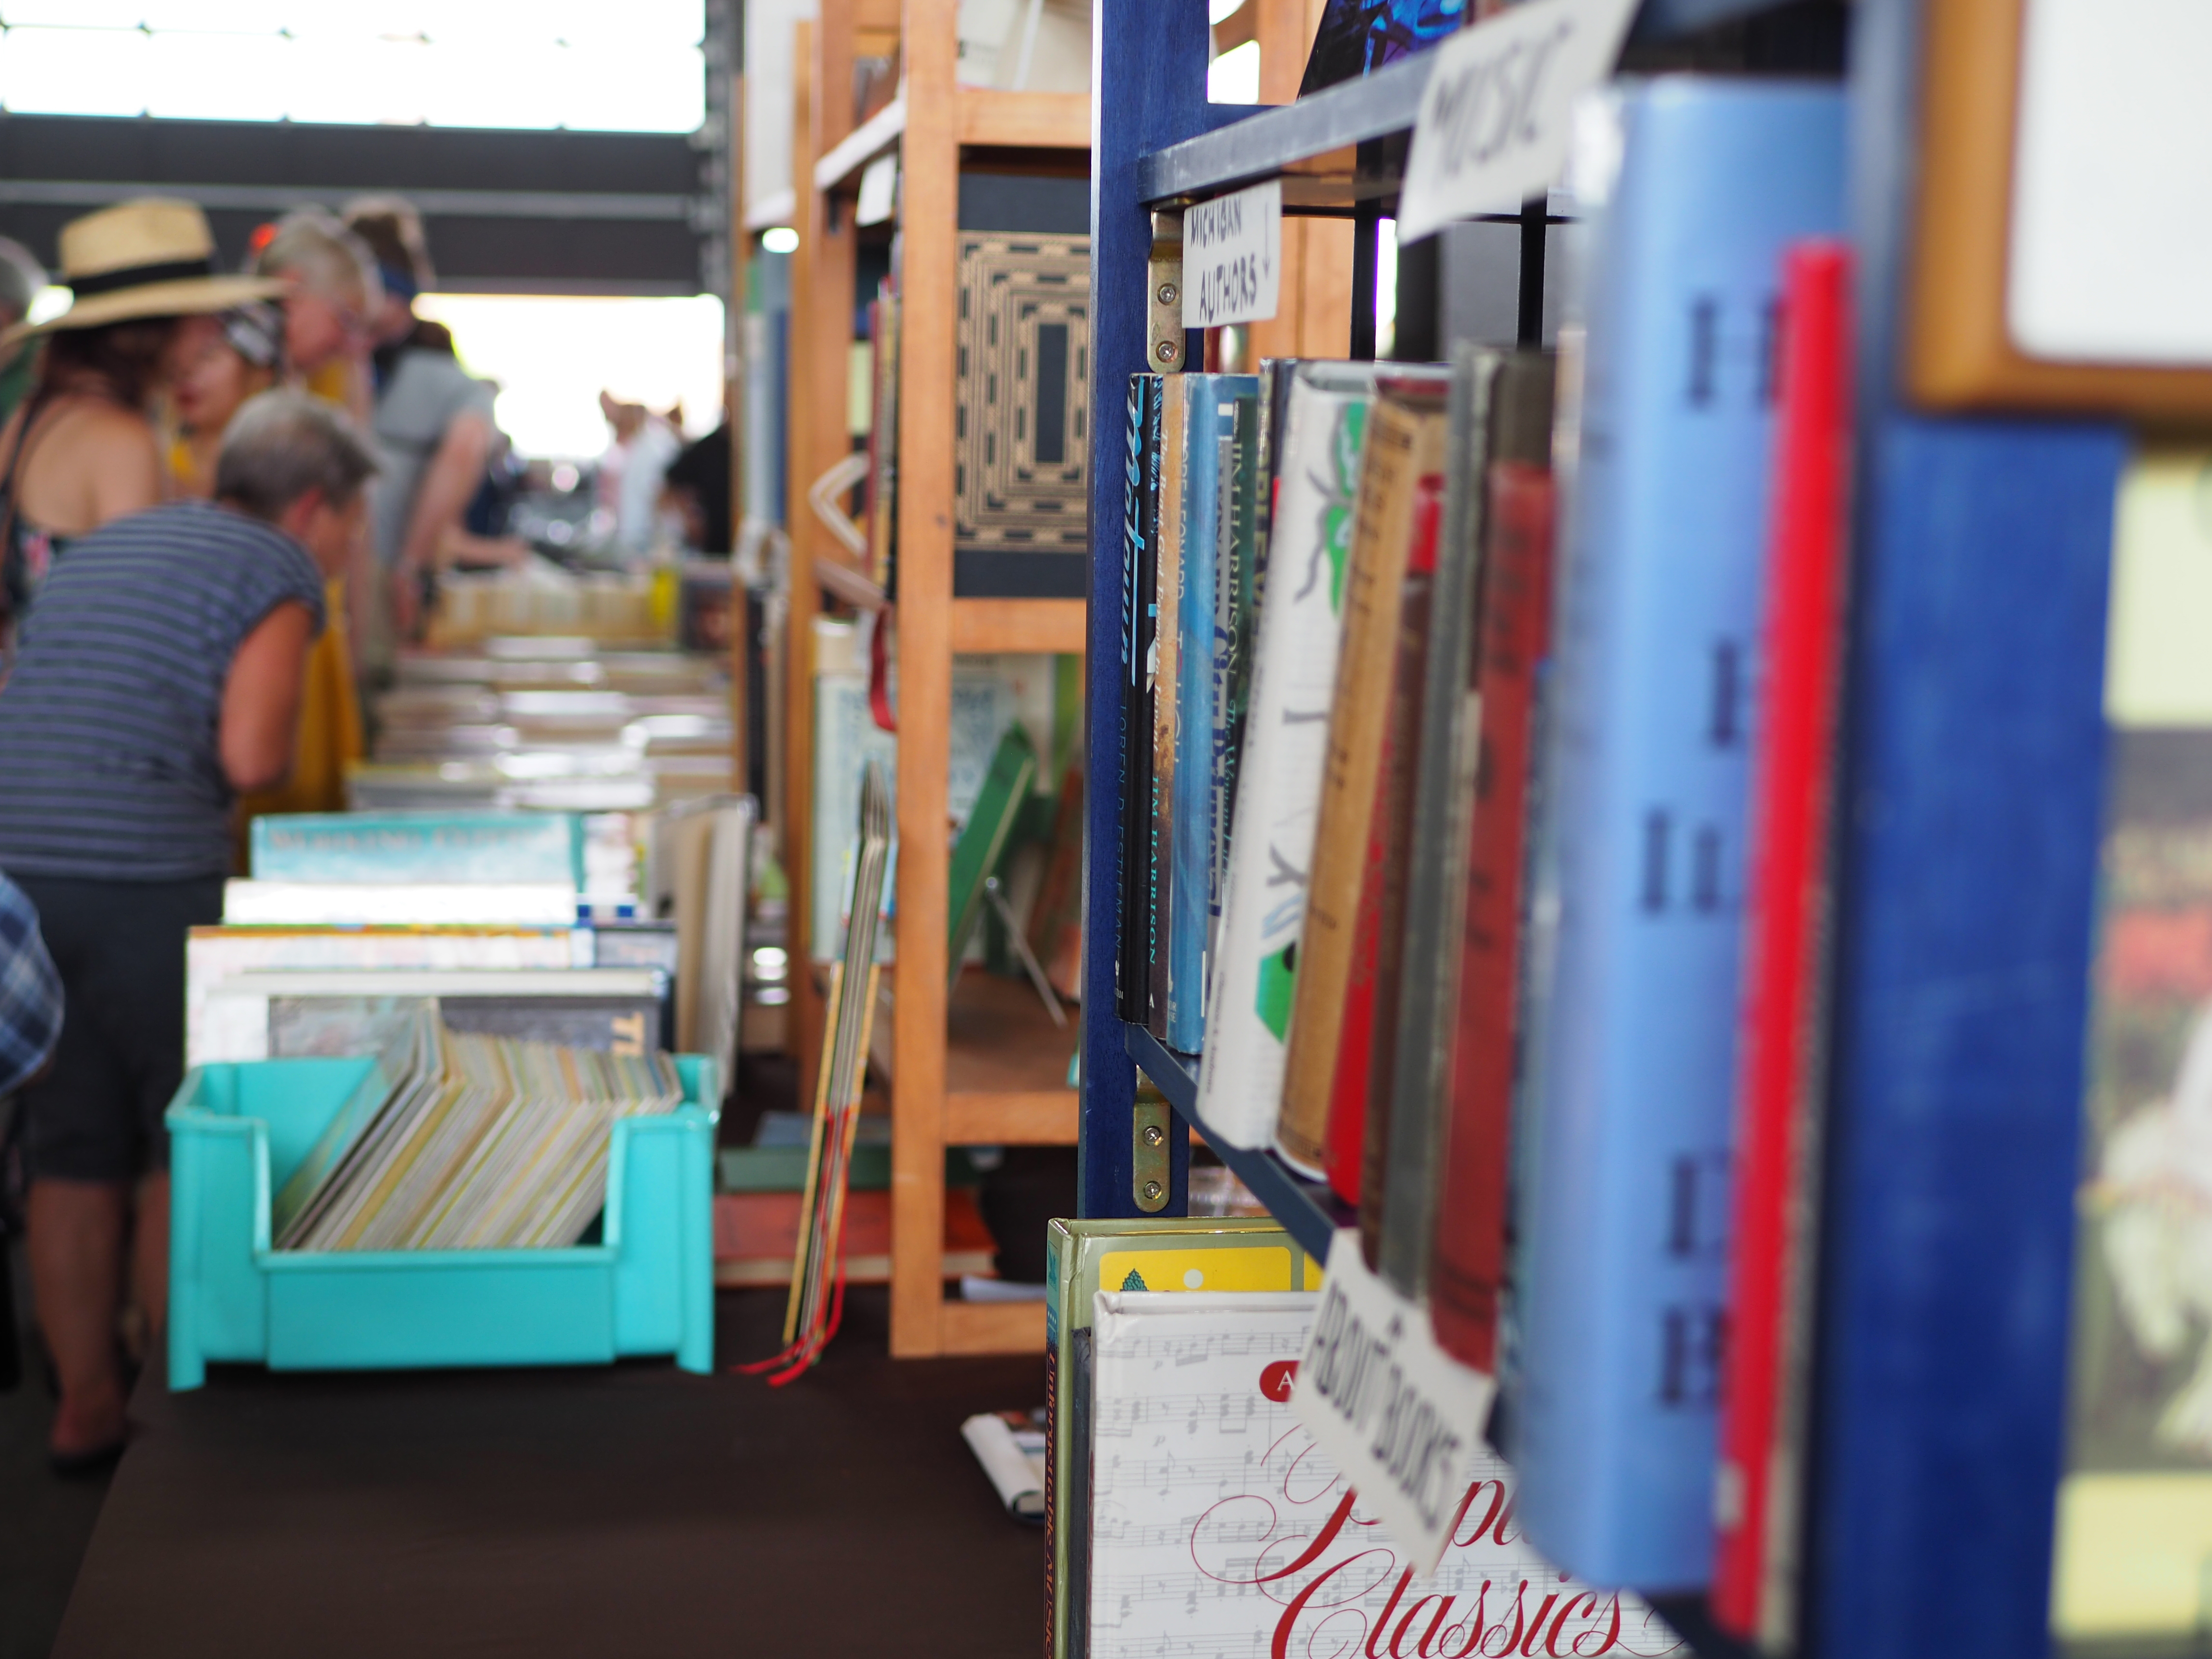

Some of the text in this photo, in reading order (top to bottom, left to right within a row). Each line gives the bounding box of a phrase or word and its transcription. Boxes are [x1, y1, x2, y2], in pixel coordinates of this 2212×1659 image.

[1190, 194, 1241, 250] MICHIGAN
[1200, 253, 1257, 324] AUTHORS
[1158, 474, 1166, 529] Beast
[1227, 505, 1240, 673] HARRISON
[1149, 830, 1158, 964] HARRISON
[1046, 1351, 1055, 1545] Unforgettable
[1257, 1548, 1625, 1659] Classics
